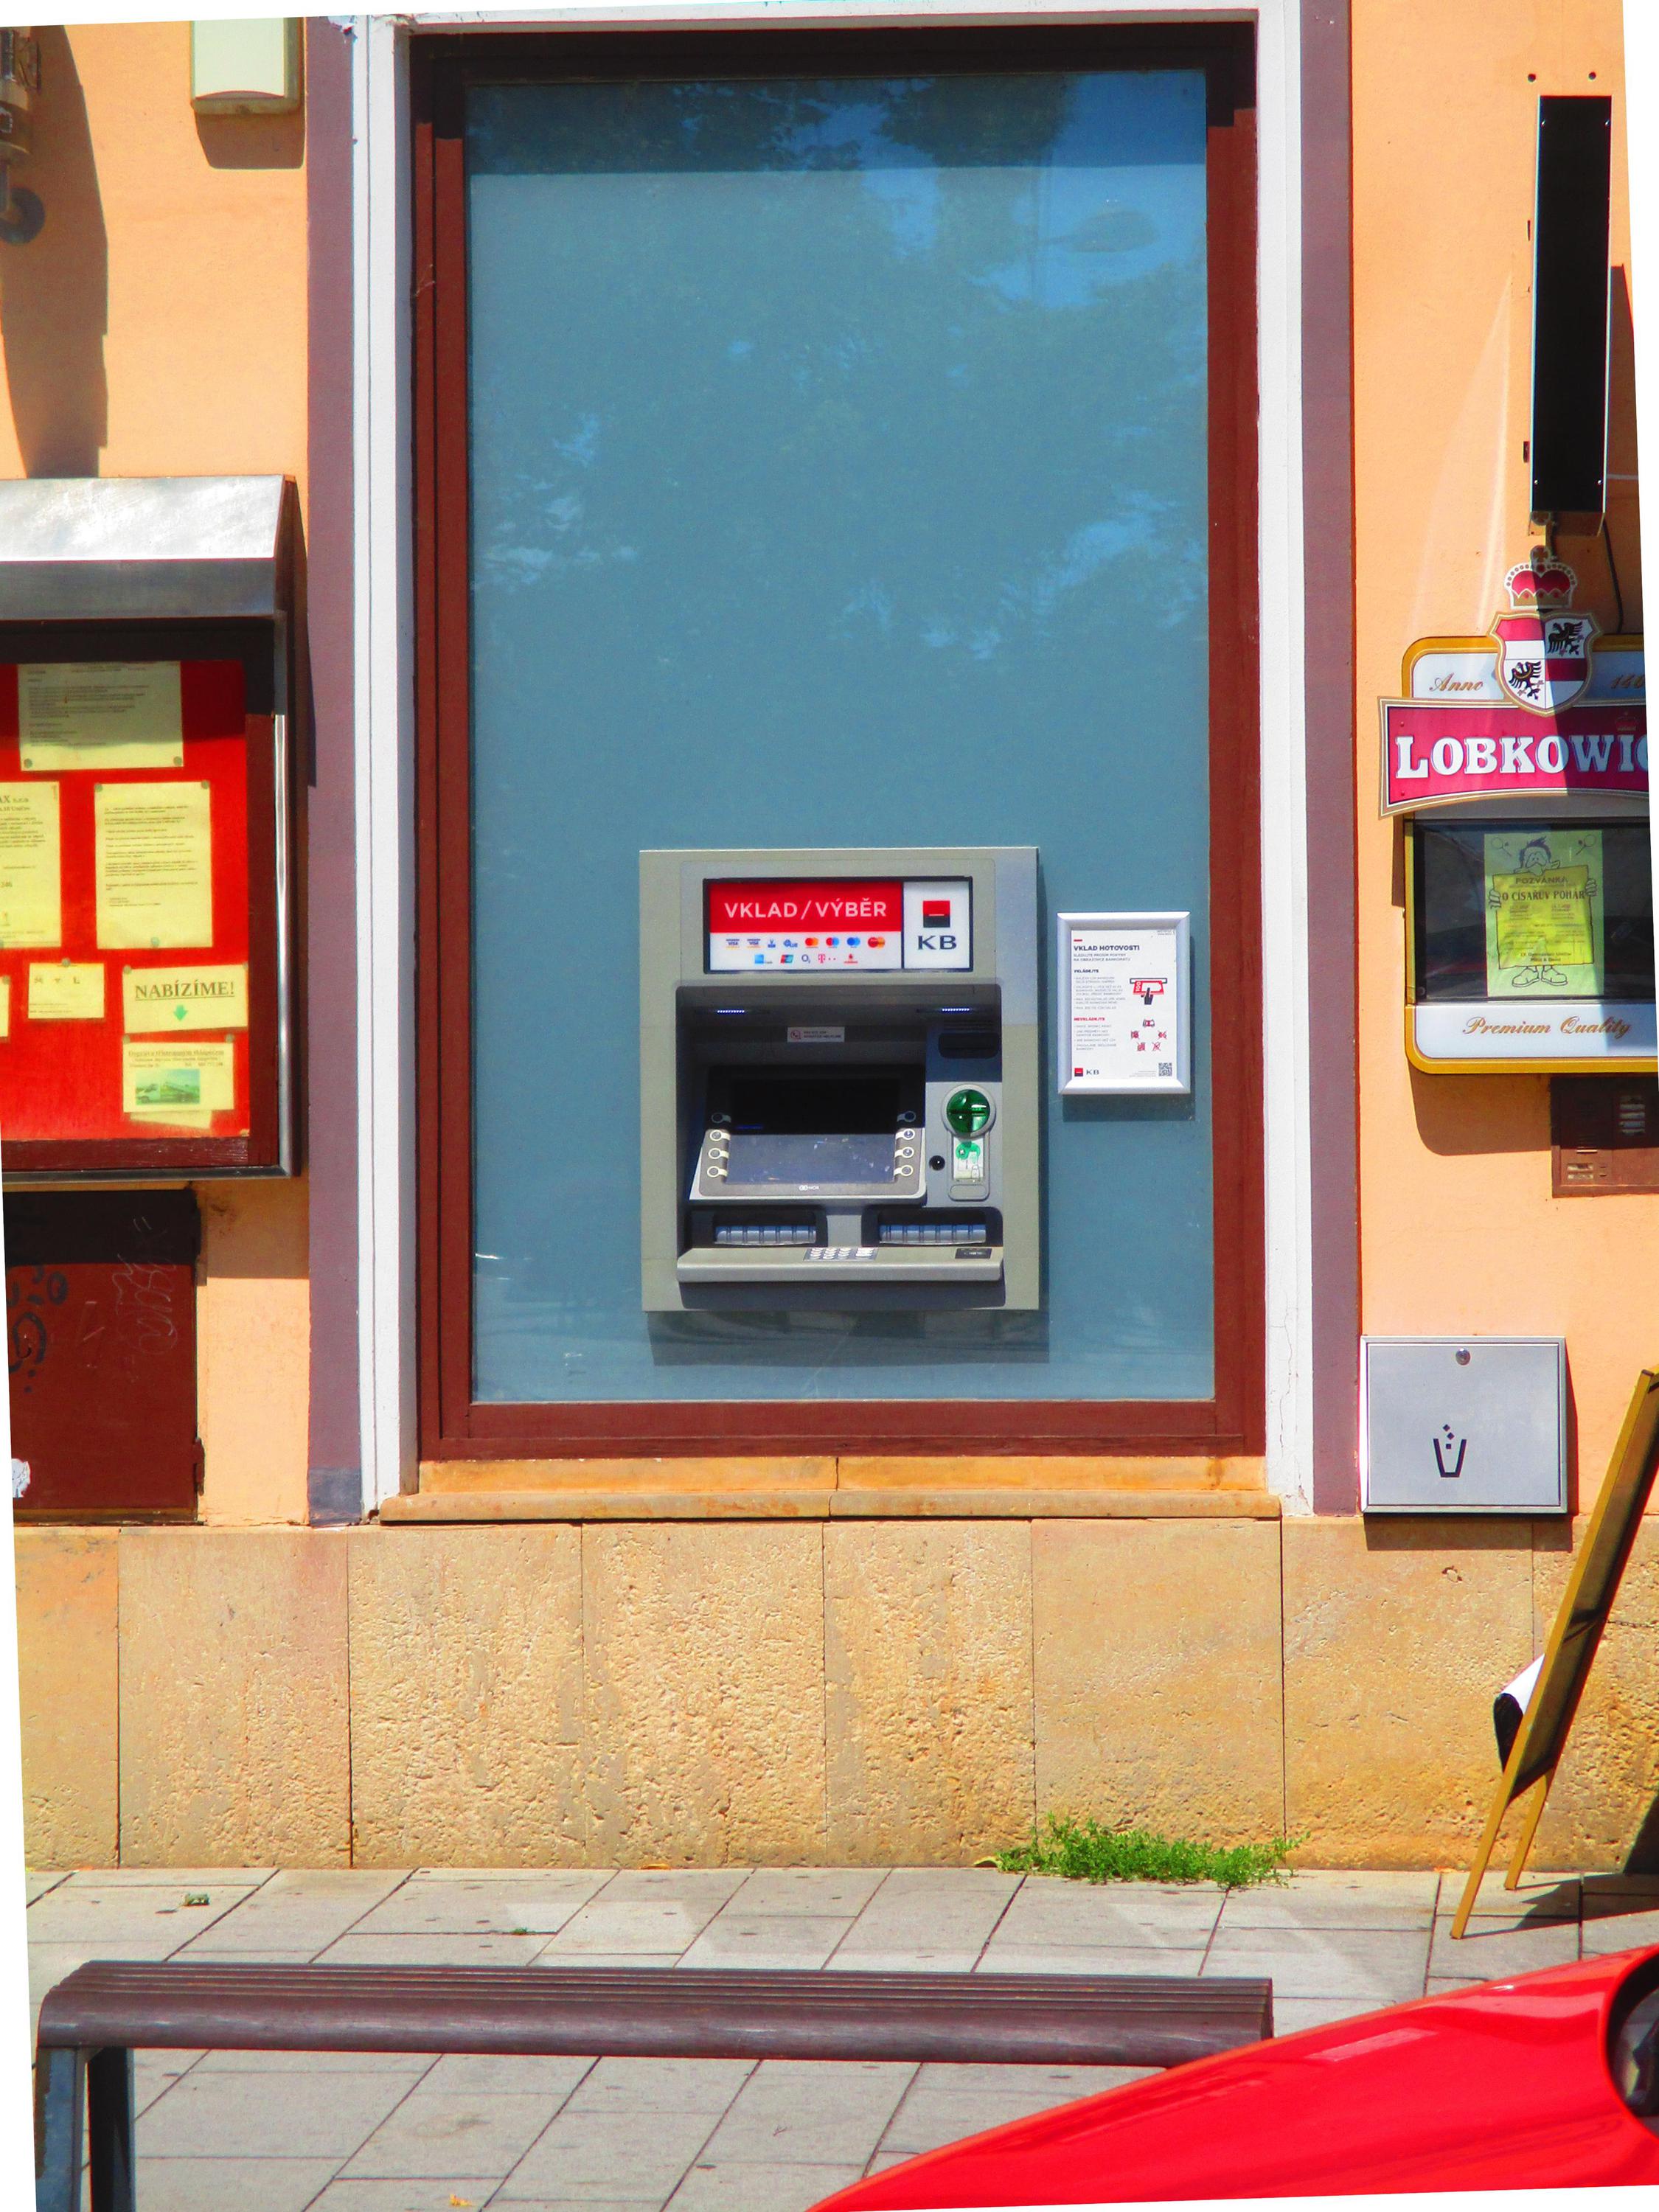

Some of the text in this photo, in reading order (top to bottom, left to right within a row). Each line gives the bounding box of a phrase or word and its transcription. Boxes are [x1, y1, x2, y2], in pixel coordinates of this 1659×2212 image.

[1429, 672, 1484, 692] Anno
[1502, 892, 1509, 900] O
[917, 935, 956, 950] KB
[135, 979, 235, 998] NABÍZÍME!
[1462, 1015, 1632, 1040] Premium Quality
